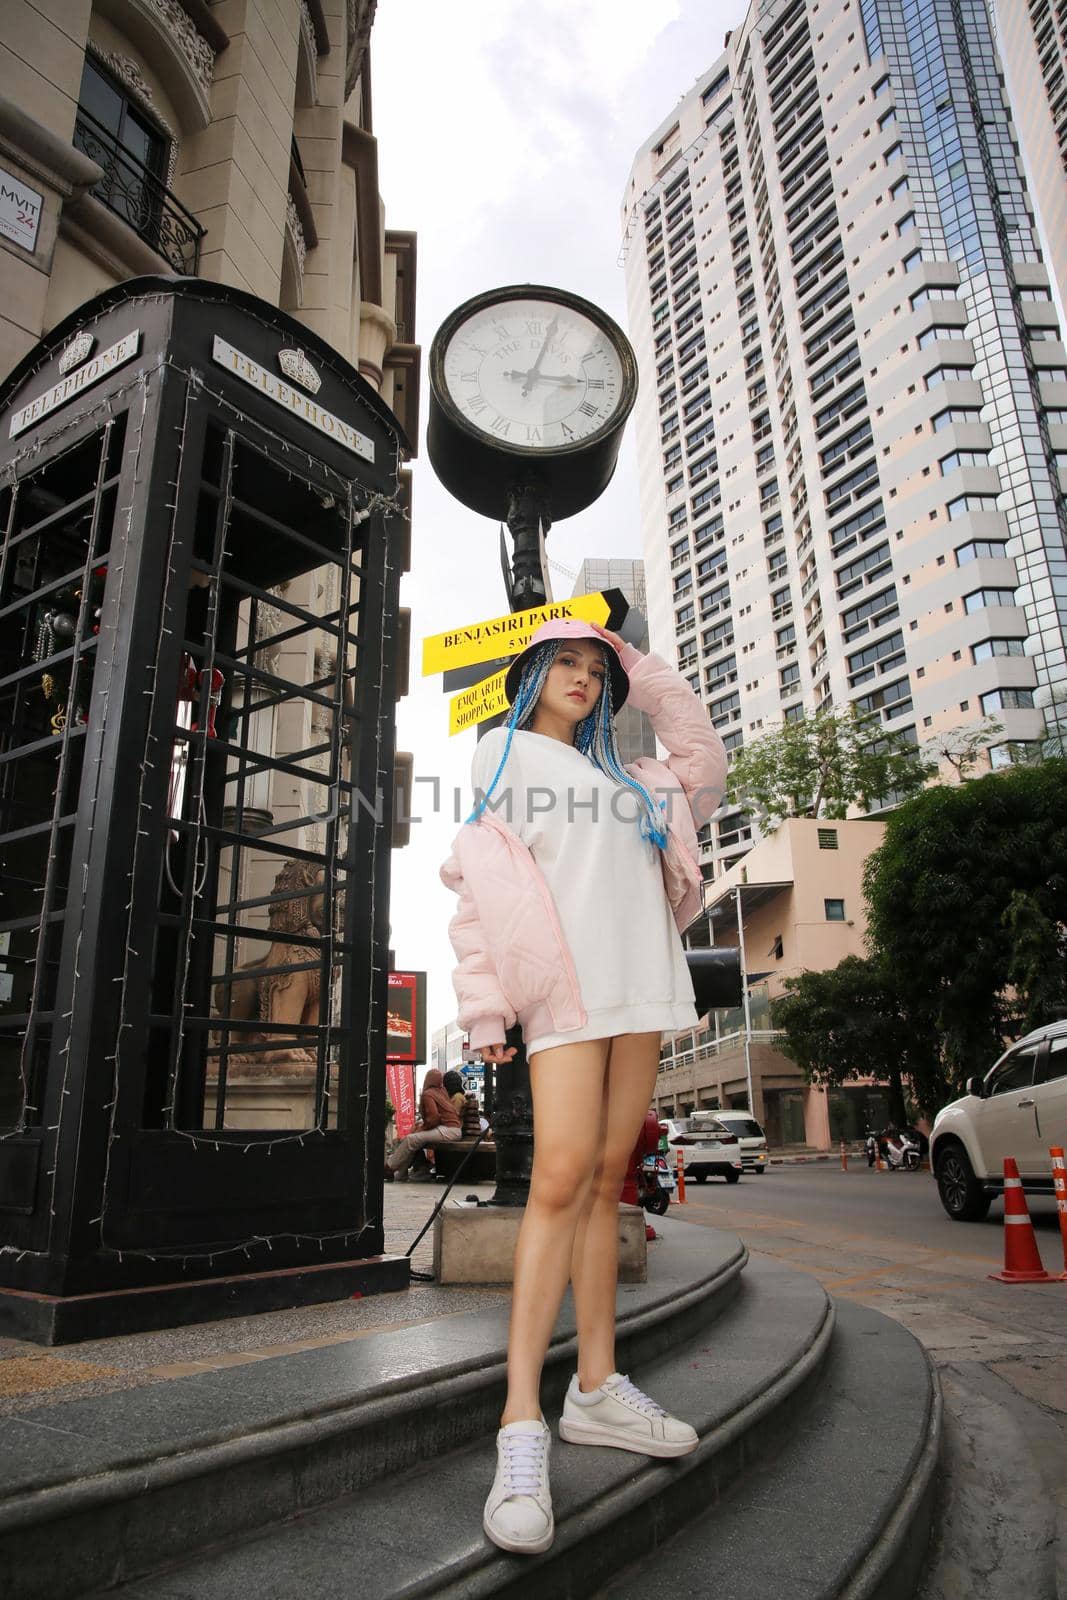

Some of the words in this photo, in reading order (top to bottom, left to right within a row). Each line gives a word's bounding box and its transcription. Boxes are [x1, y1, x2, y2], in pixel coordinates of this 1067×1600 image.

[0, 185, 39, 215] MVIT
[16, 210, 37, 229] 24
[493, 339, 521, 360] THE
[20, 341, 128, 426] TELEPHONE
[588, 378, 605, 390] III
[228, 349, 365, 452] TELEPHONE
[443, 616, 524, 648] BENJASIRI
[529, 604, 573, 626] PARK
[508, 639, 515, 649] 5
[456, 673, 506, 710] EMQUARTIE
[456, 698, 495, 728] SHOPPING
[470, 1082, 477, 1090] P
